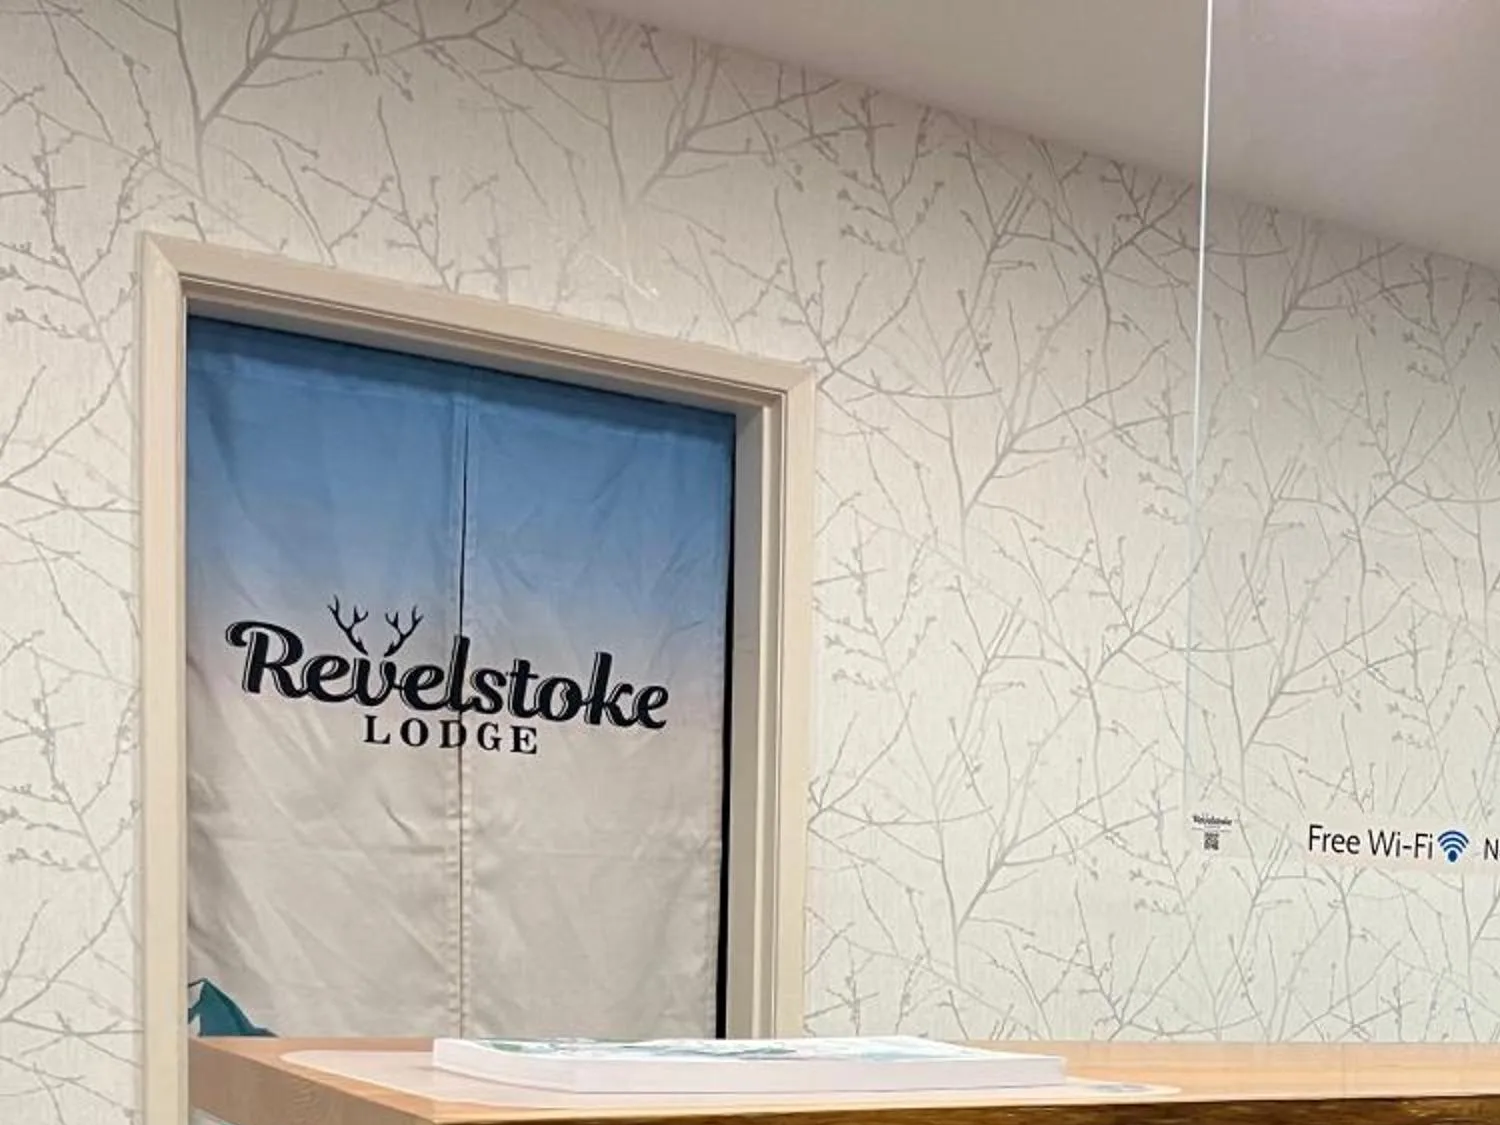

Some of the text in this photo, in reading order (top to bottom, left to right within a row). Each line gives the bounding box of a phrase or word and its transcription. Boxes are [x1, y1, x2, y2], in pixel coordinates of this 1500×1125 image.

[226, 620, 669, 730] Revelstoke
[363, 715, 538, 755] LODGE
[1308, 824, 1433, 859] Free Wi-Fi
